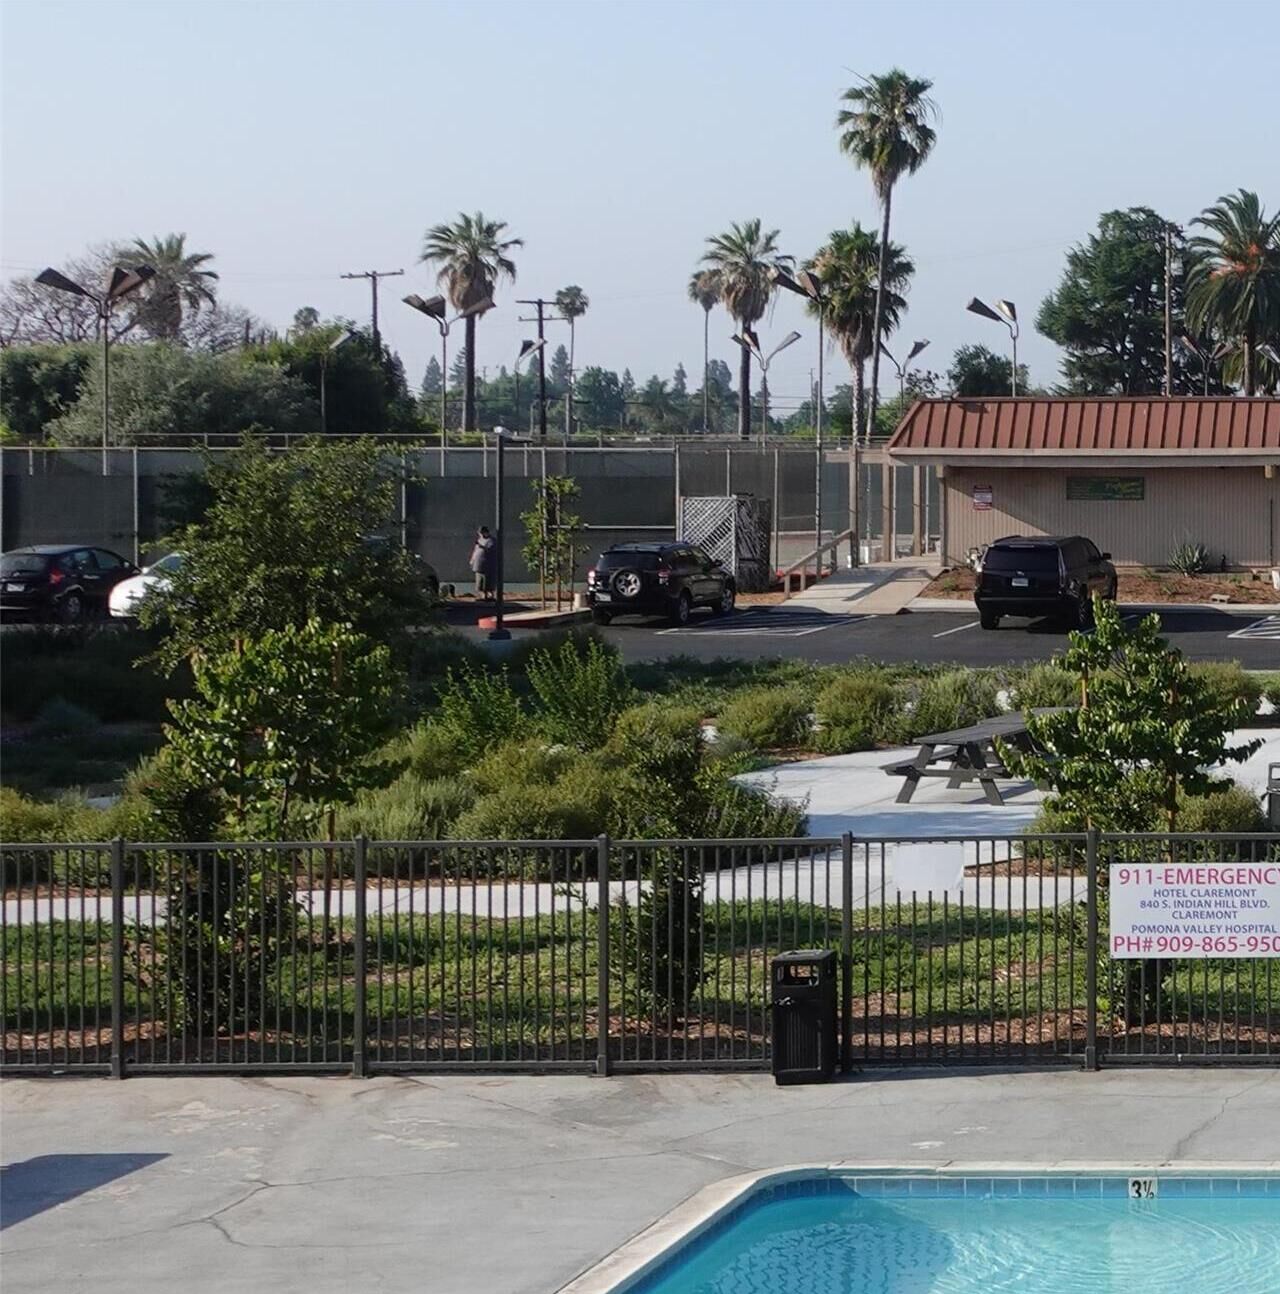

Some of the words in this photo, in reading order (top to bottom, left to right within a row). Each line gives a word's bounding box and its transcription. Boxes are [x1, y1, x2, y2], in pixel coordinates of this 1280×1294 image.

[1153, 889, 1188, 898] HOTEL
[1190, 888, 1256, 898] CLAREMONT
[1140, 900, 1160, 909] 840
[1162, 900, 1171, 909] S.
[1173, 900, 1211, 909] INDIAN
[1214, 900, 1238, 909] HILL
[1240, 899, 1270, 909] BLVD.
[1171, 911, 1238, 920] CLAREMONT
[1131, 924, 1180, 934] POMONA
[1183, 924, 1223, 934] VALLEY
[1225, 924, 1277, 934] HOSPITAL
[1114, 936, 1153, 952] PH#
